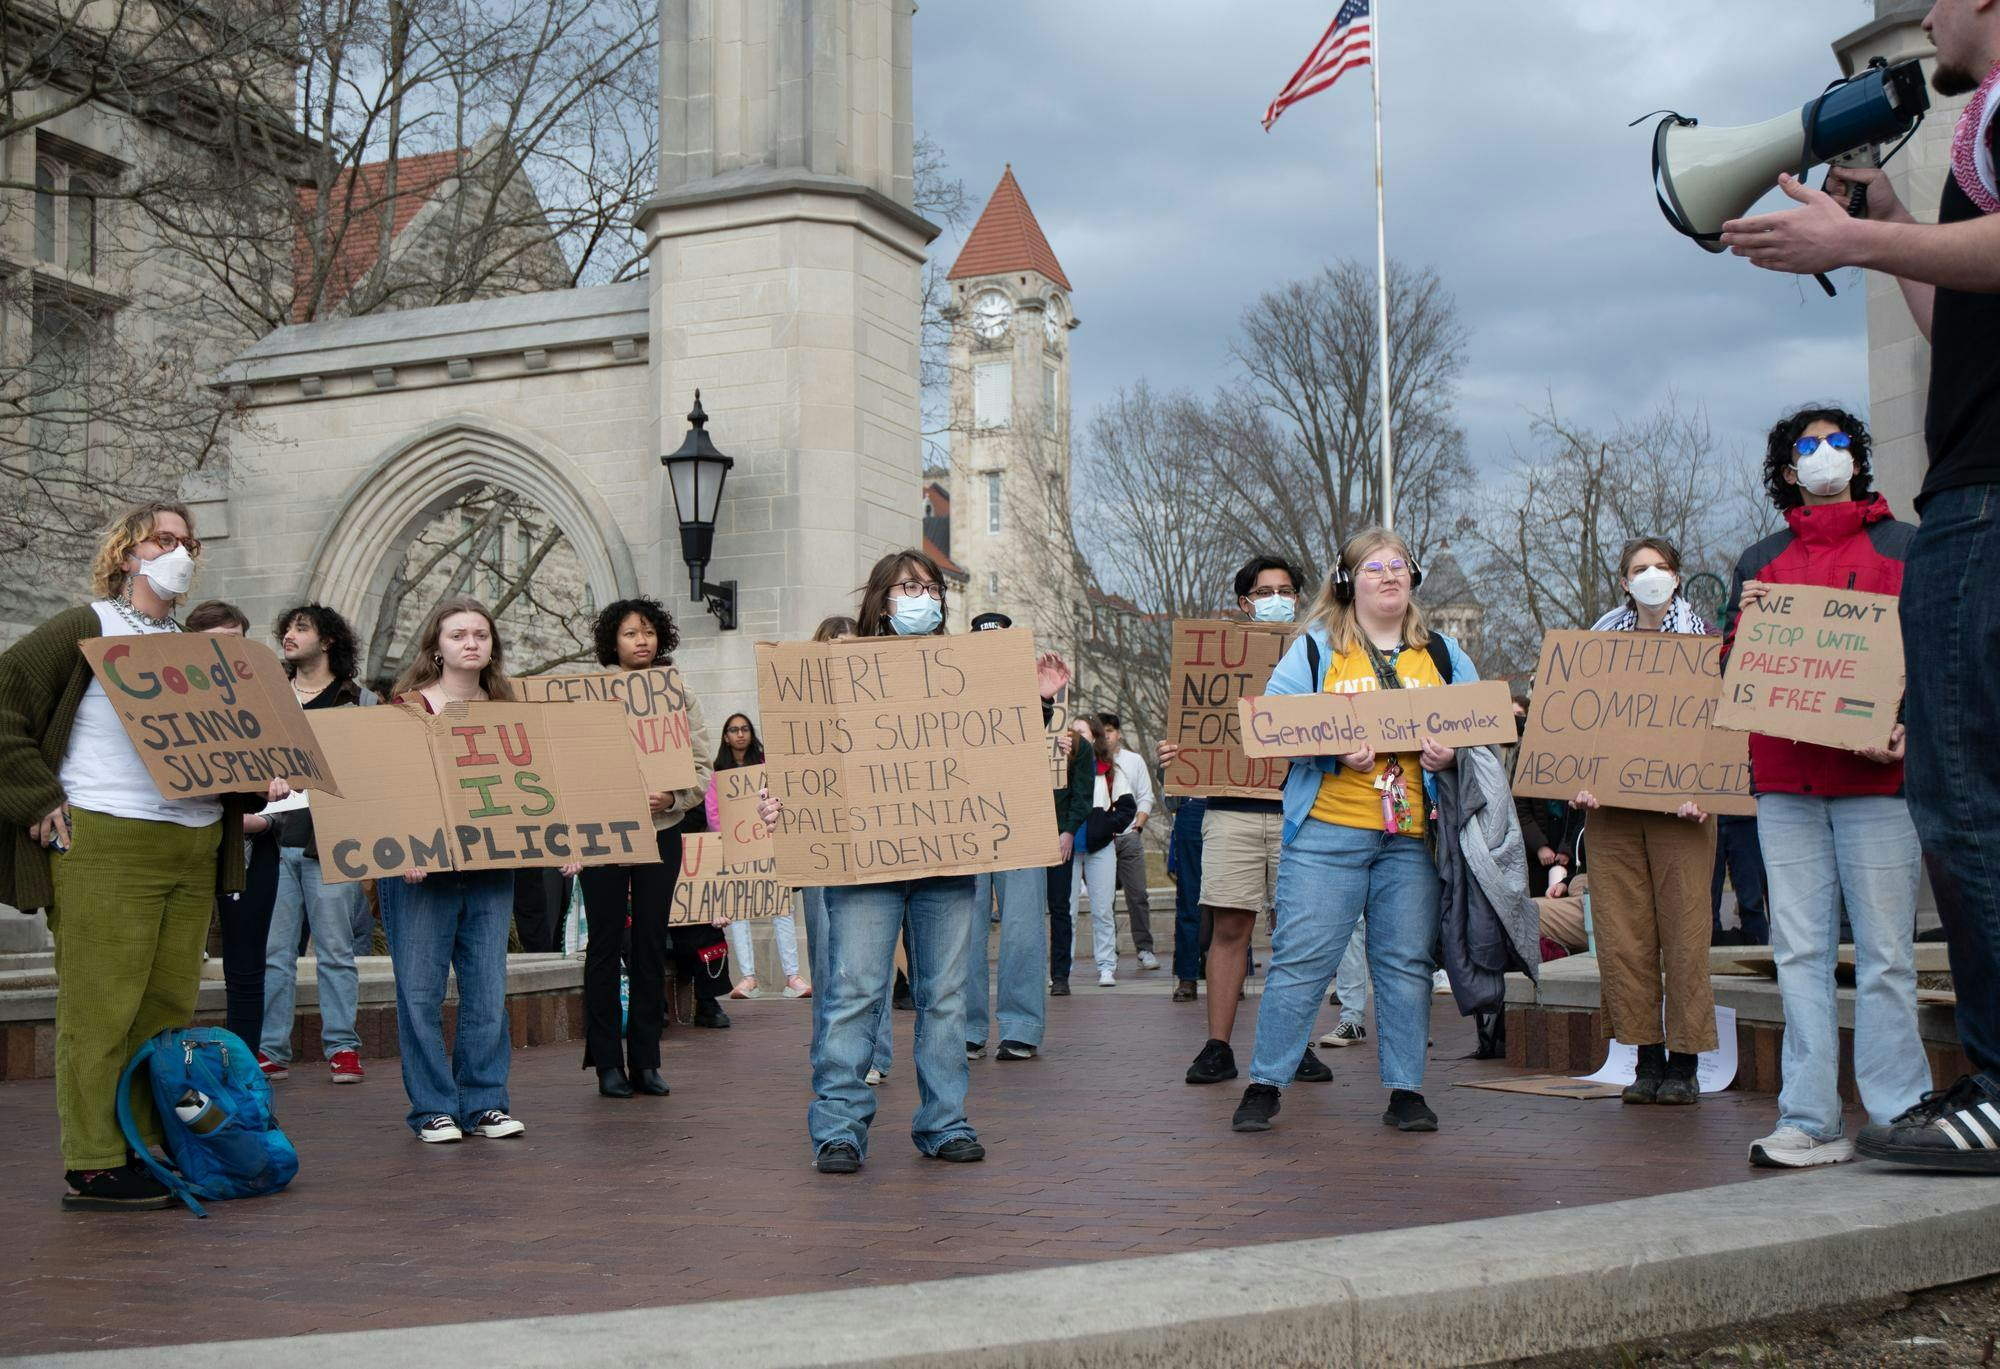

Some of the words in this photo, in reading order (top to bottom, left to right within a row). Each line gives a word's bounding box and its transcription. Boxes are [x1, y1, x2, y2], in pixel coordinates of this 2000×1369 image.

[1757, 596, 1794, 614] WE
[1823, 600, 1886, 623] DON'T
[1184, 629, 1249, 668] IU
[1748, 623, 1804, 647] STOP
[1816, 629, 1869, 651] UNTIL
[102, 638, 254, 705] Google
[771, 651, 893, 705] WHERE
[916, 647, 966, 699] IS
[1739, 651, 1857, 679] PALESTINE
[1182, 672, 1253, 706] NOT
[1733, 683, 1755, 703] IS
[1768, 686, 1826, 713] FREE
[781, 718, 854, 756] IU'S
[874, 705, 1027, 751] SUPPORT
[1178, 711, 1241, 745] FOR
[1251, 712, 1369, 746] Genocide
[1426, 709, 1499, 734] Complex
[1541, 689, 1718, 733] COMPLICAT
[451, 722, 533, 767] IU
[784, 767, 843, 798] FOR
[859, 757, 970, 793] THEIR
[1176, 748, 1284, 789] STUDE
[1518, 751, 1608, 785] ABOUT
[1619, 757, 1750, 792] GENOCID
[459, 771, 556, 819] IS
[781, 791, 1009, 835] PALESTINIAN
[332, 820, 640, 878] COMPLICIT
[668, 879, 792, 924] SLAMOPHOBIA
